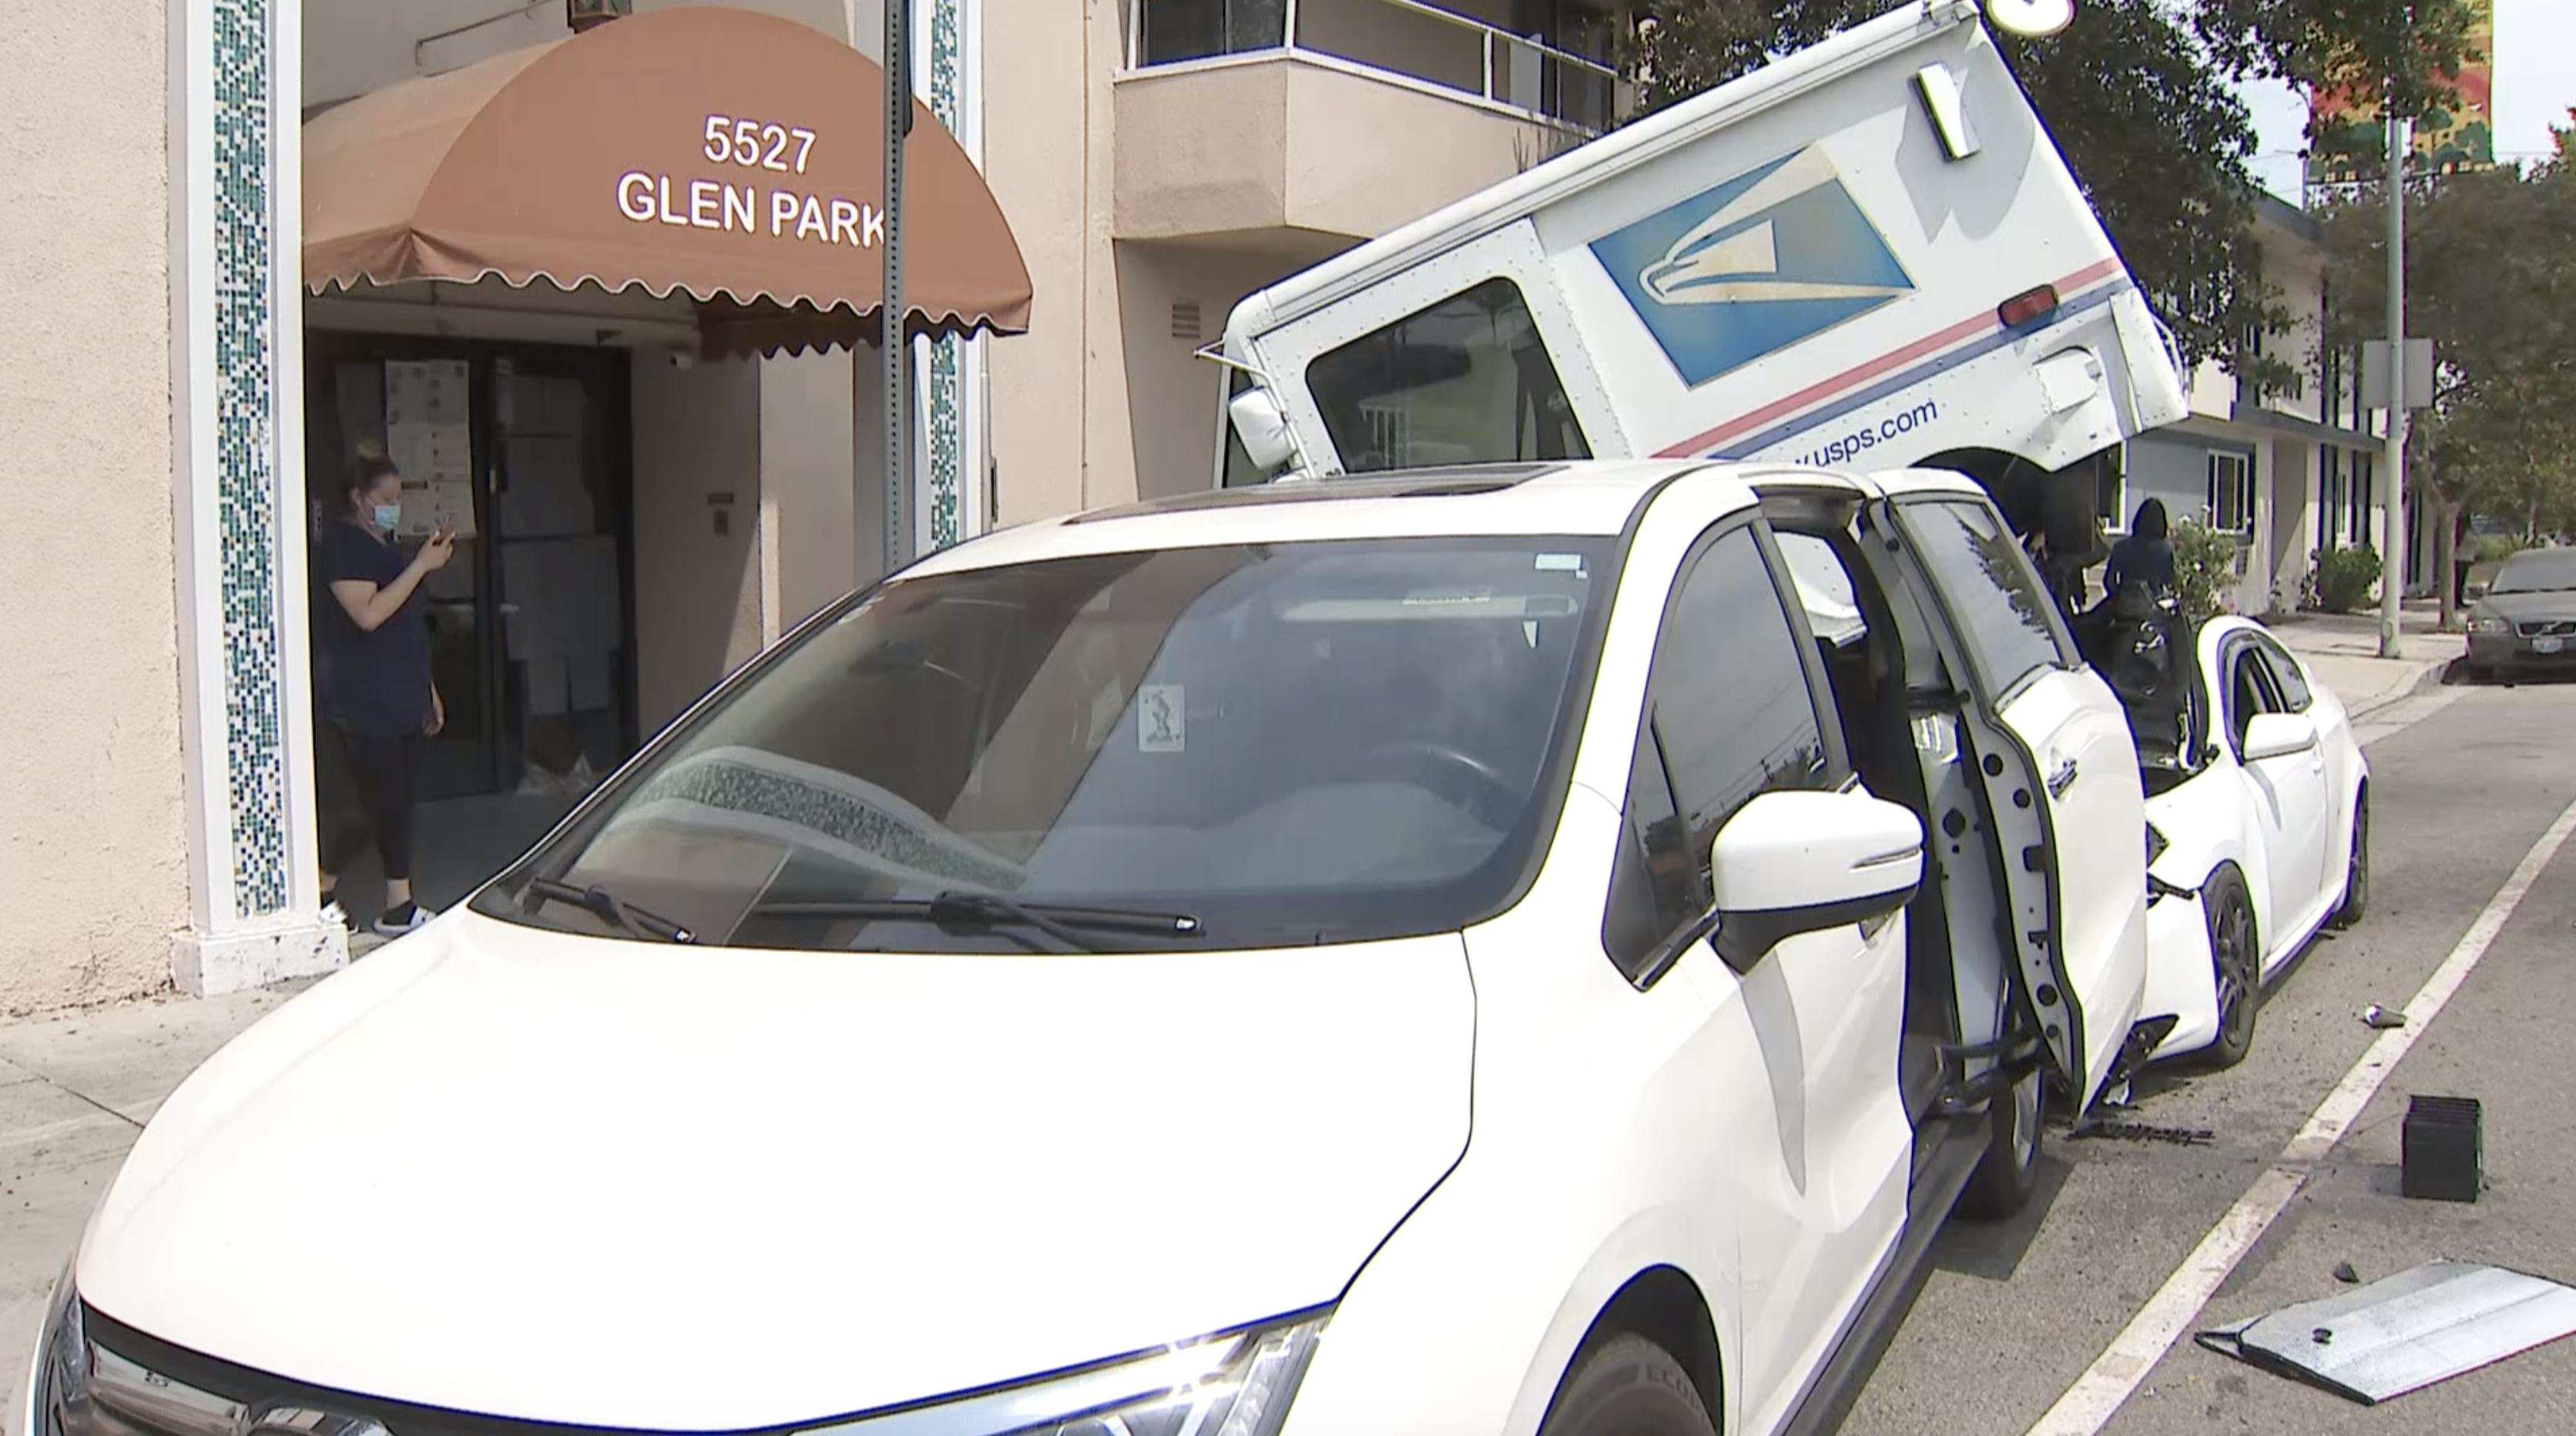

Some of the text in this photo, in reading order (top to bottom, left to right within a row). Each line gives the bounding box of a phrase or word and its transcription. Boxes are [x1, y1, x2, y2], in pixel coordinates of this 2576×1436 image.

[703, 114, 817, 174] 5527
[617, 170, 884, 247] GLEN PARK
[1795, 399, 1938, 467] usps.com
